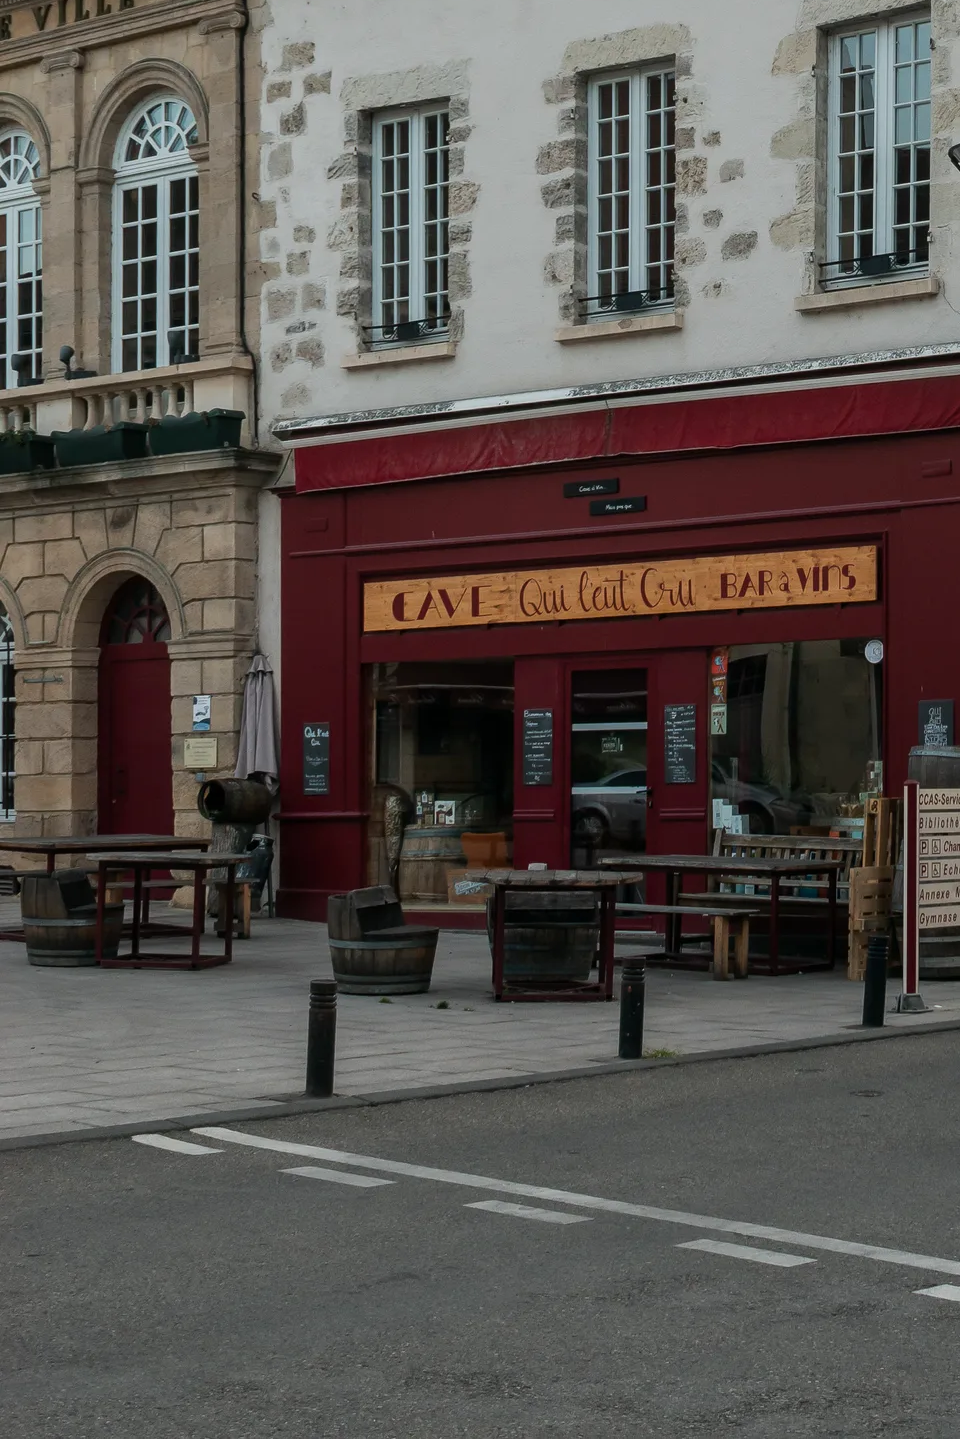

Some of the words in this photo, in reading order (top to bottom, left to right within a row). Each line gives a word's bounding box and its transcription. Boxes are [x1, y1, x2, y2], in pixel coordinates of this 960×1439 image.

[392, 585, 493, 622] CAVE
[520, 577, 571, 617] Qui
[640, 567, 694, 608] Cru
[720, 570, 773, 598] BAR
[919, 888, 950, 901] Annexe
[919, 912, 957, 926] Gymnase
